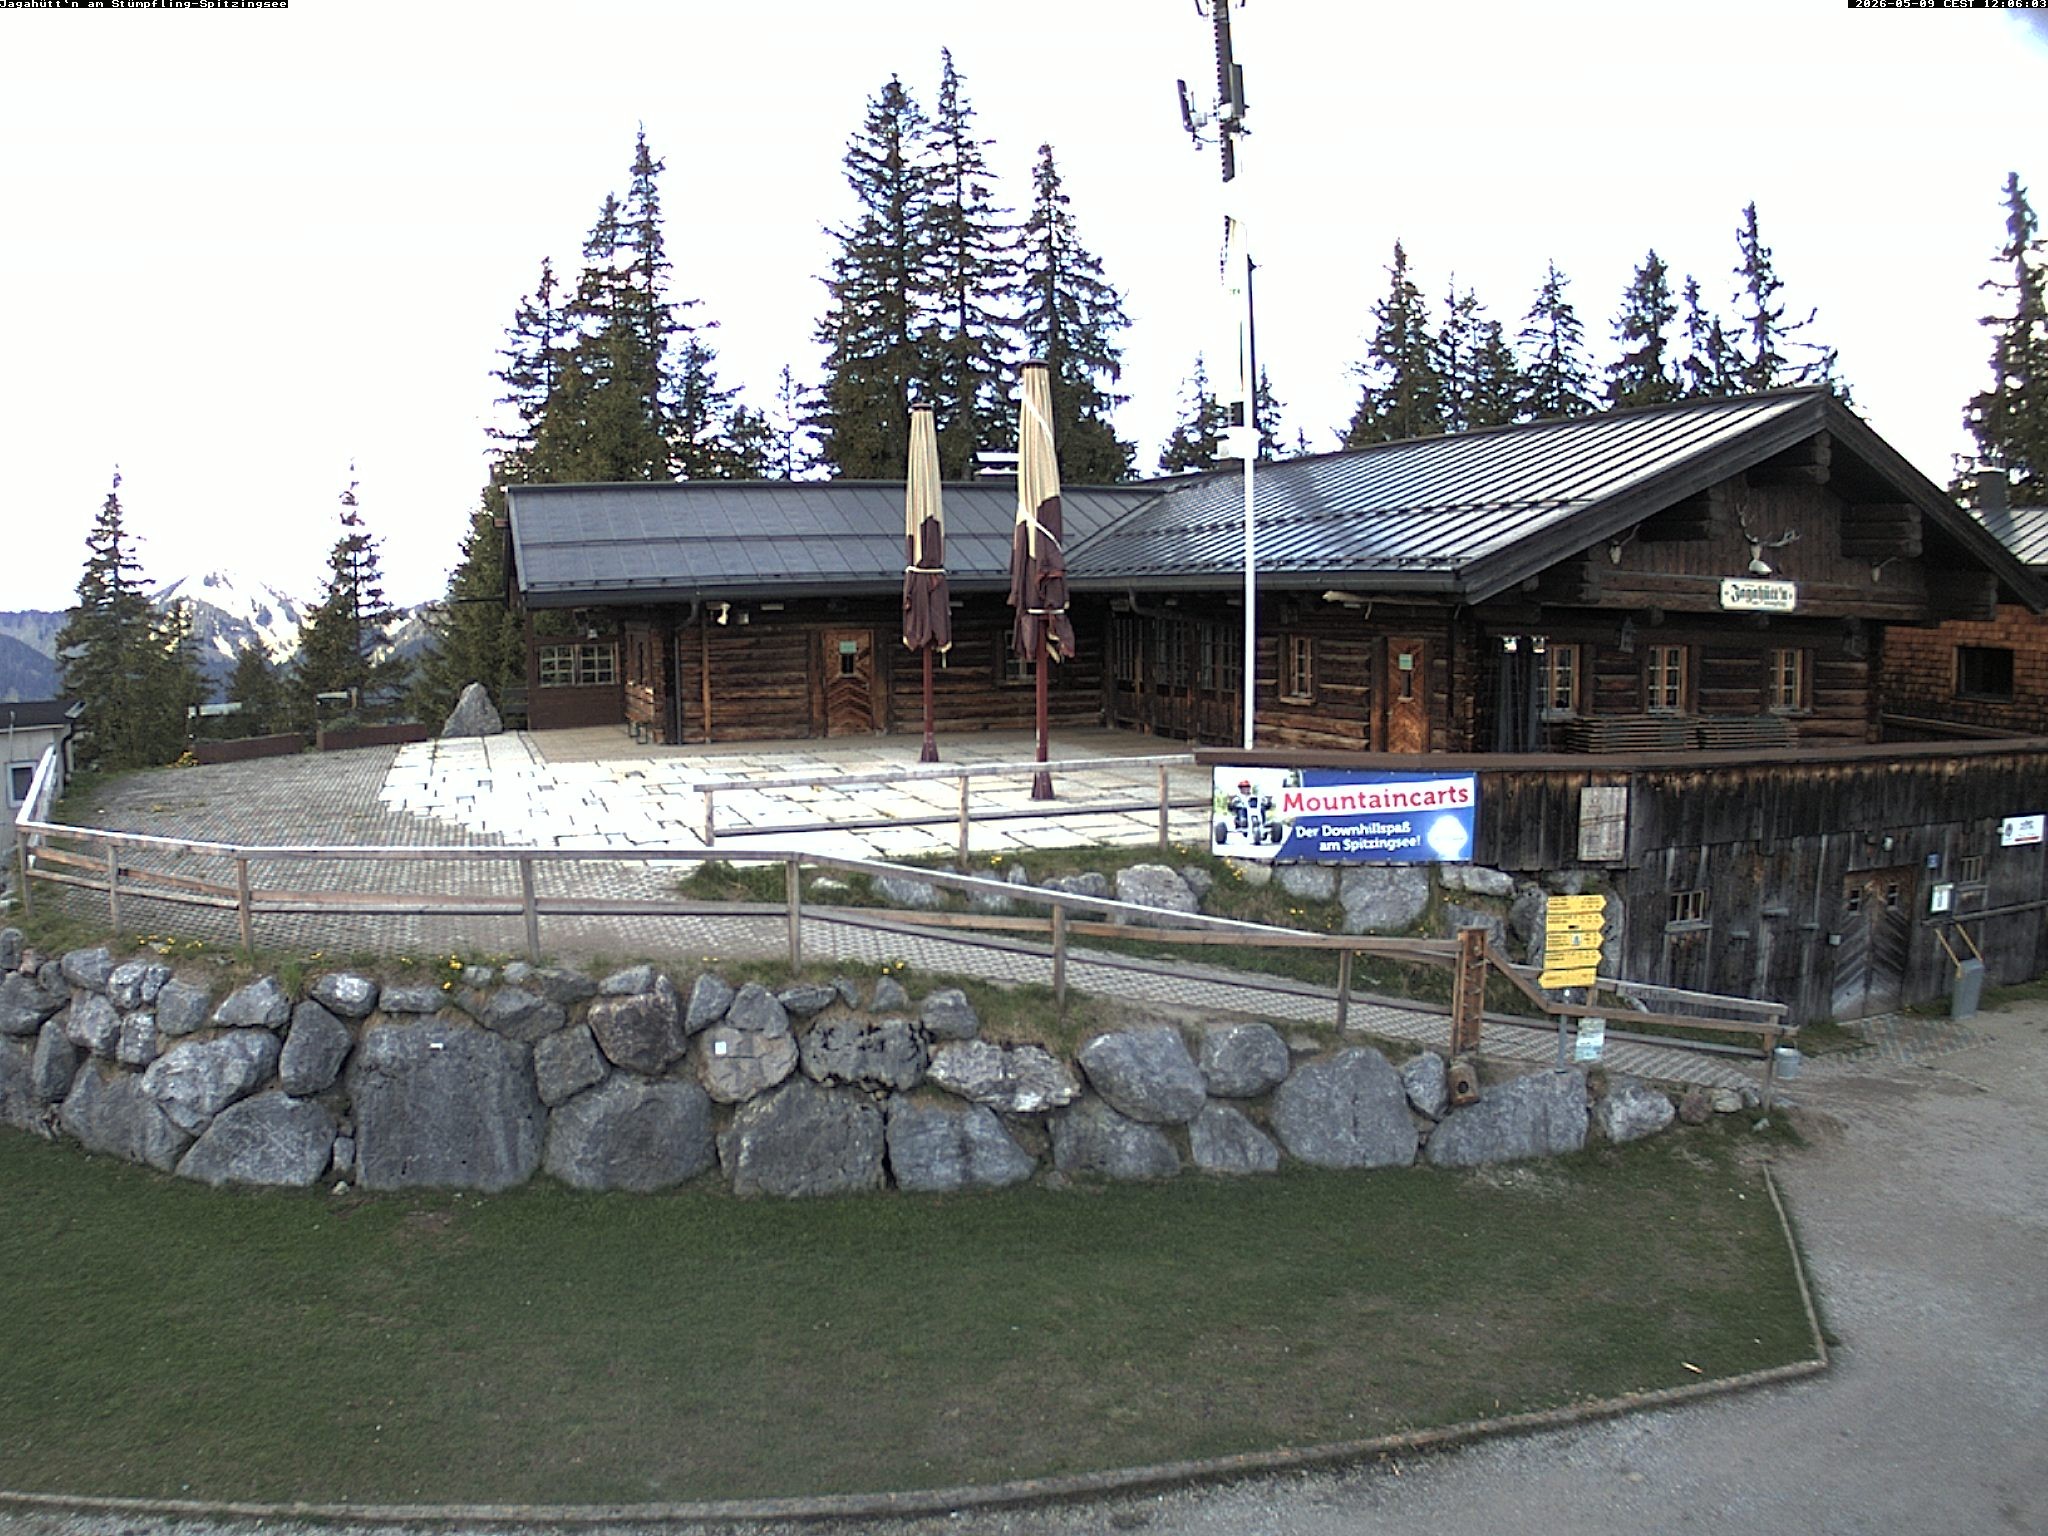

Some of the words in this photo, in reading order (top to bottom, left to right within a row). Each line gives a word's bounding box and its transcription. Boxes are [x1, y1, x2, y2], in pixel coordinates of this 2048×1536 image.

[1283, 785, 1469, 812] Mountaincarts
[1296, 825, 1318, 838] Der
[1322, 821, 1411, 838] Downhillspaß
[1319, 840, 1341, 851] am
[1344, 836, 1421, 853] Spitzingsee!
